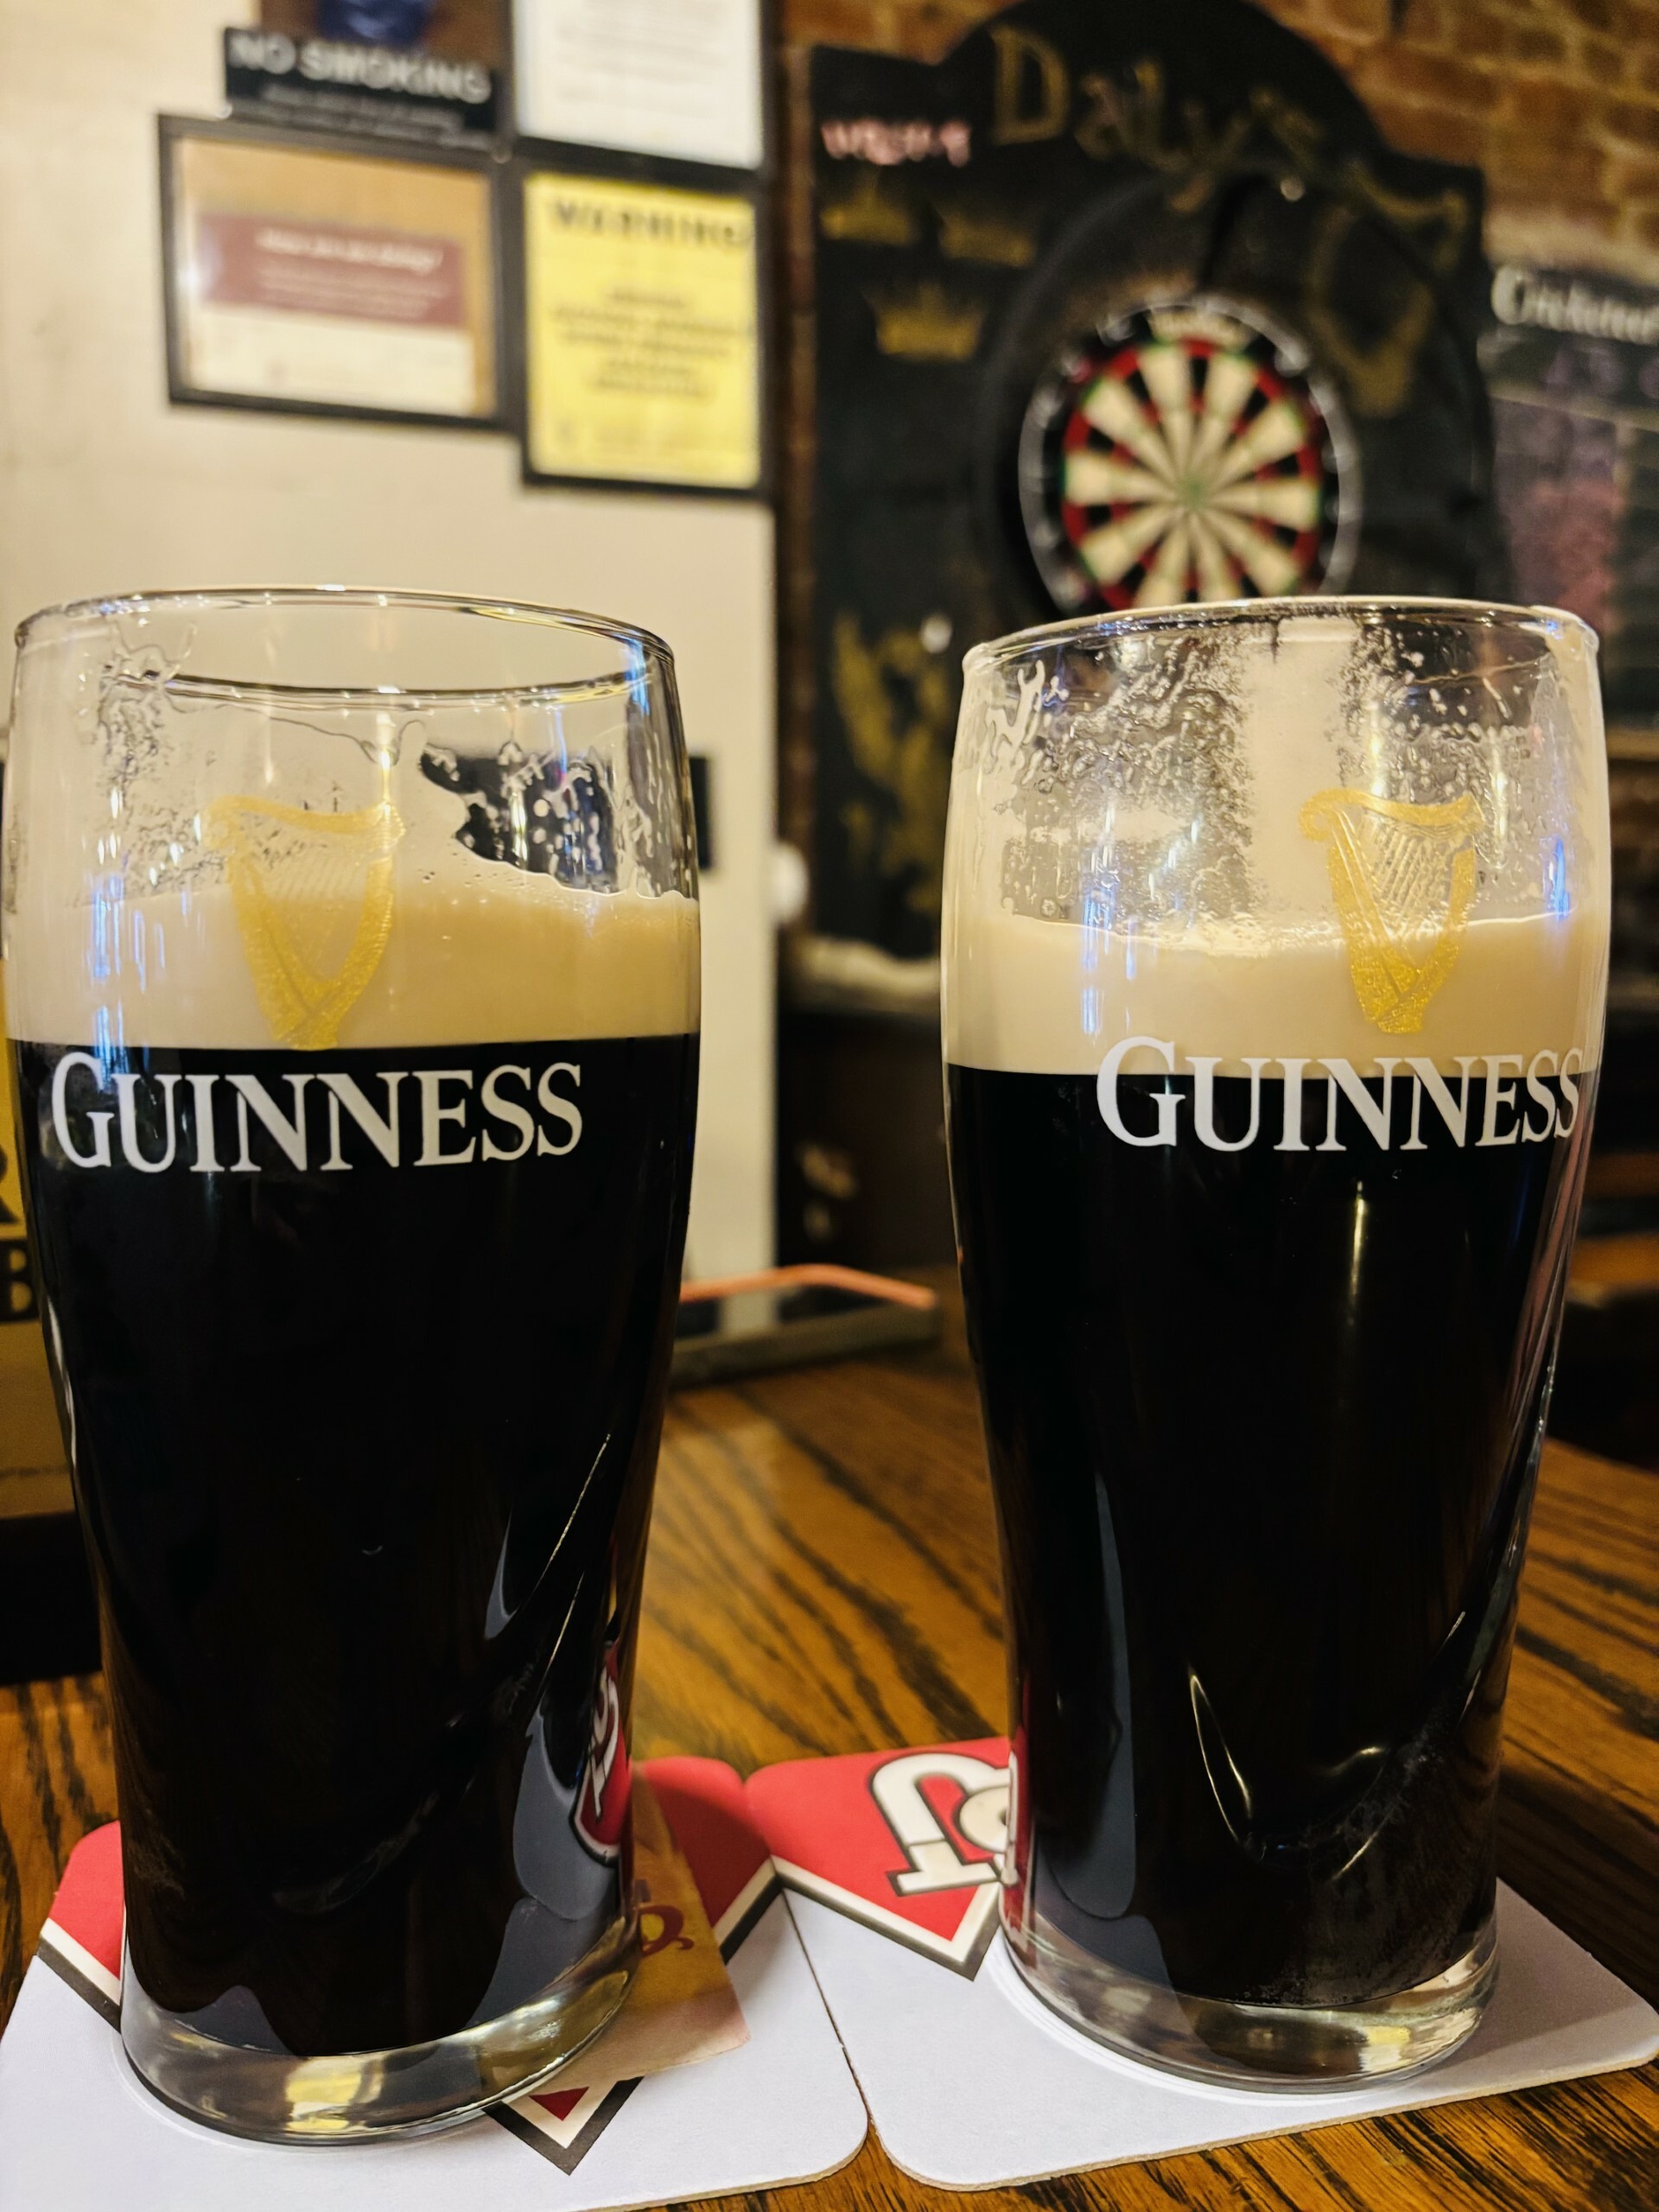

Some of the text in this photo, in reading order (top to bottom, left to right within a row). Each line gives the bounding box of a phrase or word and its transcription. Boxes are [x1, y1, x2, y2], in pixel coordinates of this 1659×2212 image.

[228, 31, 296, 75] NO
[299, 40, 492, 104] SMOKING
[51, 1051, 584, 1173] GUINNESS
[1096, 1035, 1584, 1153] GUINNESS
